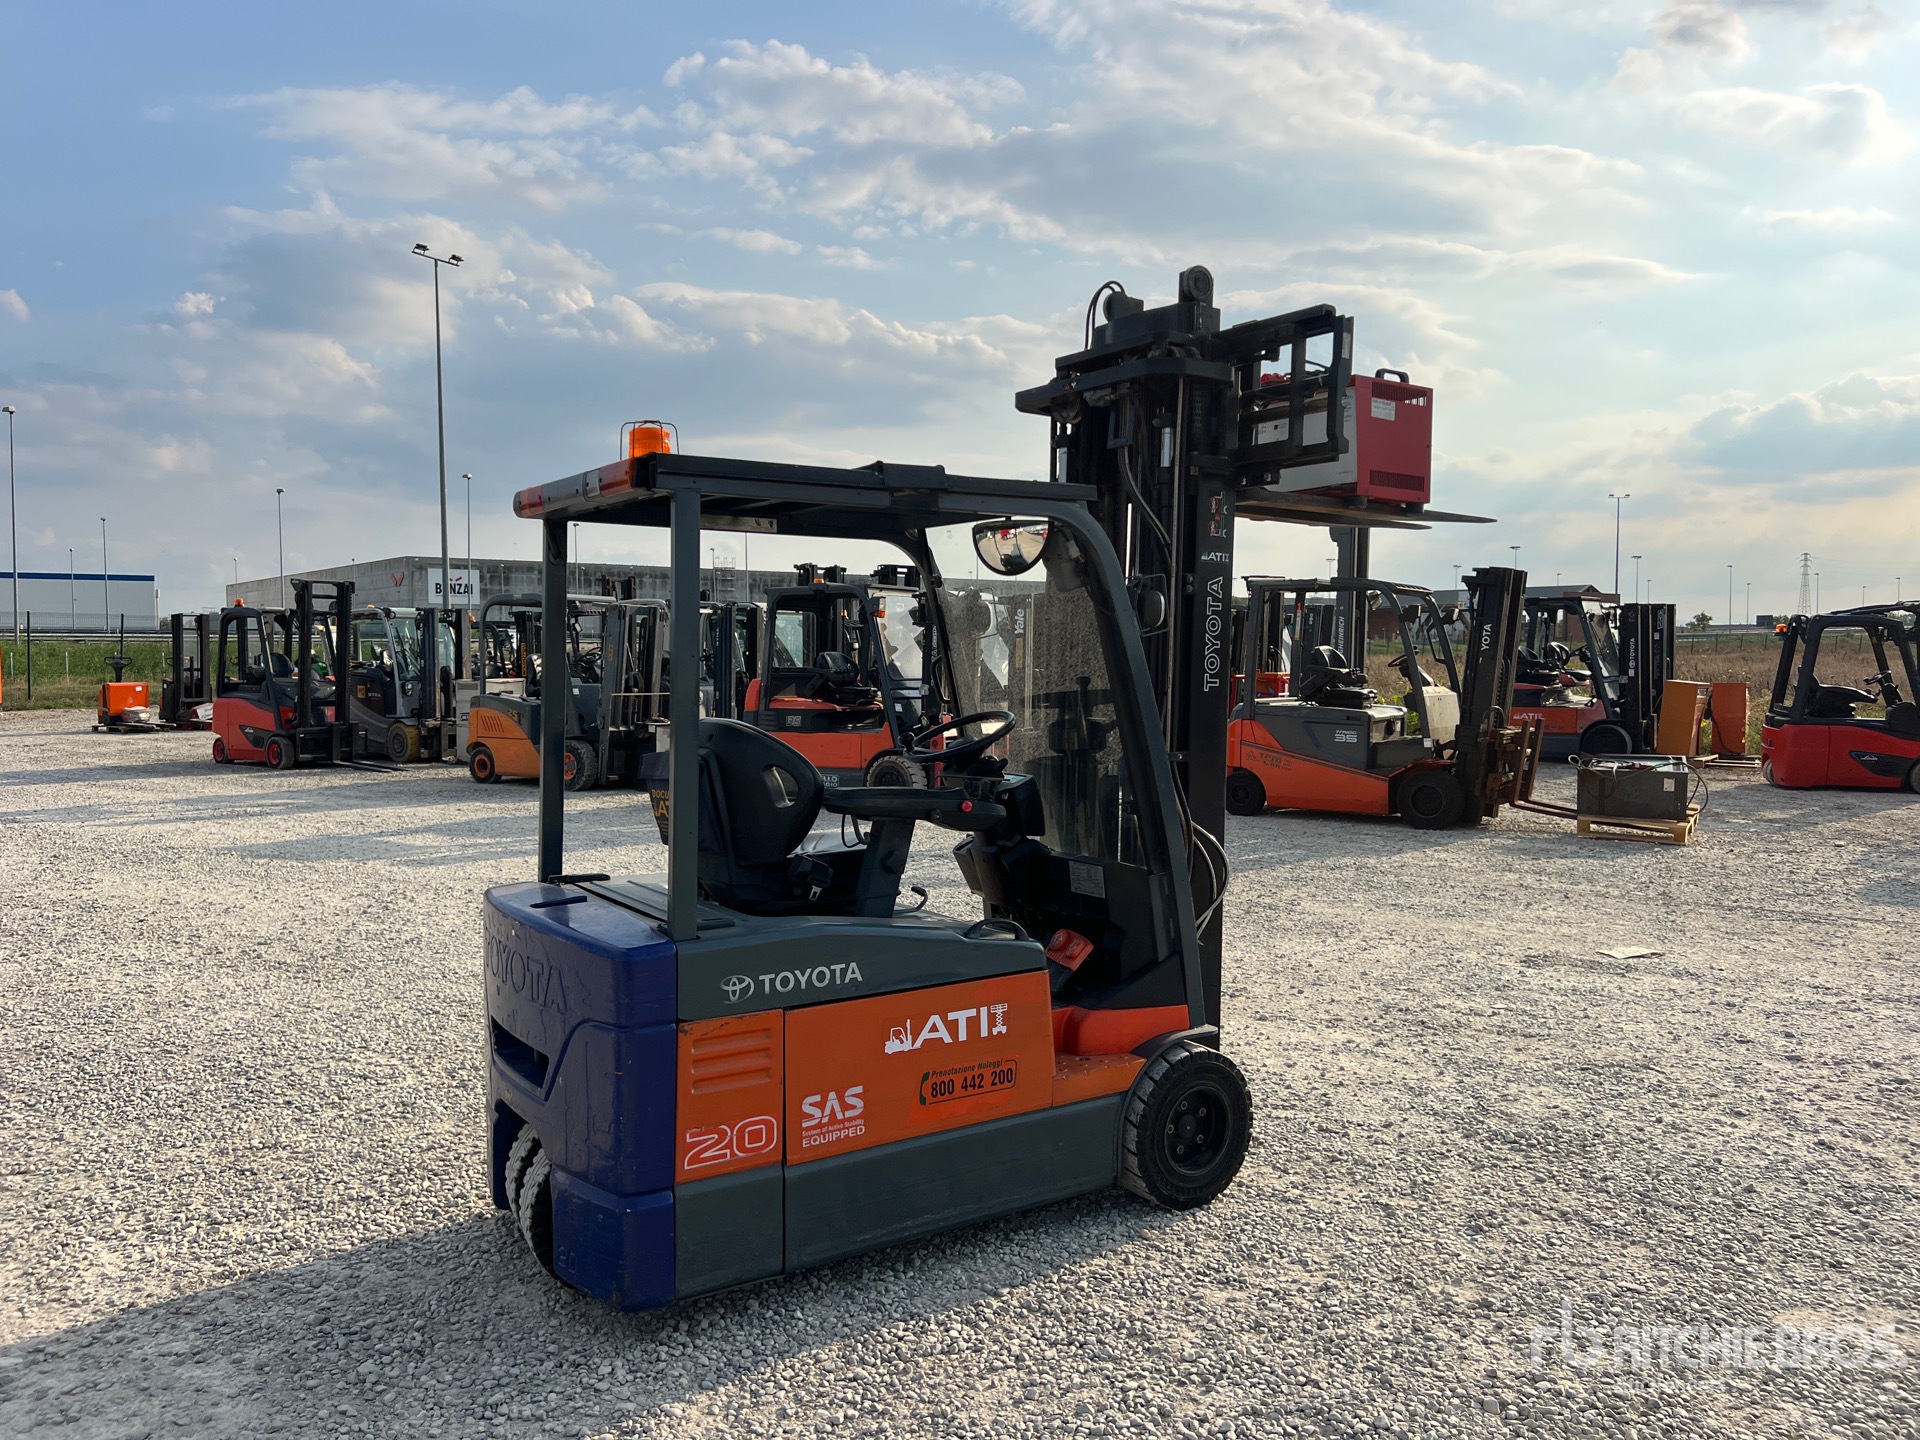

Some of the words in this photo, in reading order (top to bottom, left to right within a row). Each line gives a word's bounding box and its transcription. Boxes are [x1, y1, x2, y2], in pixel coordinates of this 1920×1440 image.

[435, 582, 473, 595] BNZAI
[1014, 608, 1025, 634] Yale
[1204, 575, 1223, 692] TOYOTA
[785, 715, 802, 727] 35
[1334, 733, 1358, 743] 35
[651, 789, 671, 799] DOCU
[486, 935, 569, 1015] OYOTA
[759, 961, 863, 995] TOYOTA
[930, 1078, 955, 1099] 800
[961, 1073, 985, 1092] 442
[990, 1067, 1014, 1087] 200
[931, 1064, 976, 1079] Prenotazione
[802, 1085, 864, 1128] SAS
[684, 1115, 778, 1170] 20
[802, 1127, 822, 1137] System
[822, 1125, 829, 1133] of
[802, 1125, 866, 1148] EQUIPPED
